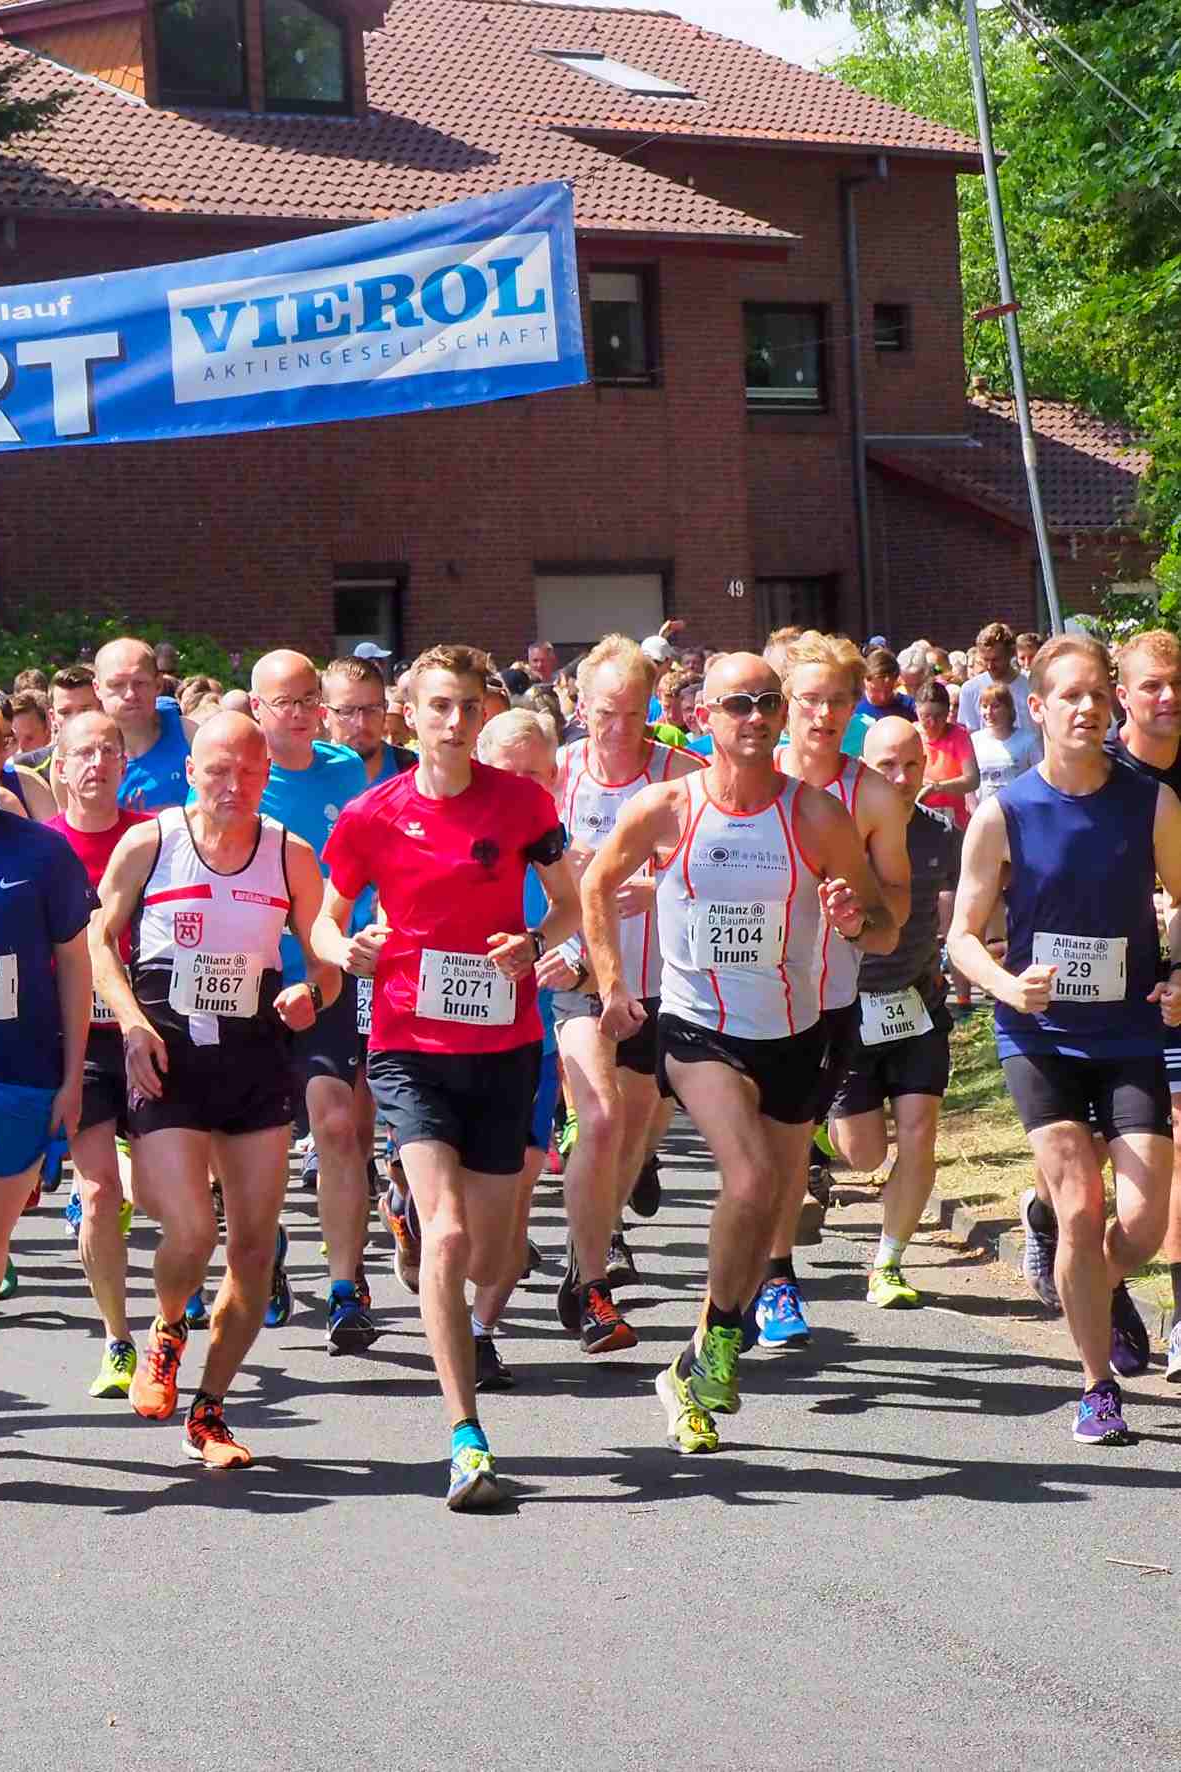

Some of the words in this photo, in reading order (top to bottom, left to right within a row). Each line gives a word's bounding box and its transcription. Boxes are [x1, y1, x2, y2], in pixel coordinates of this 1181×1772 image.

[180, 256, 547, 354] VIEROL
[203, 326, 548, 381] AKTIENGESELLSCHAFT
[727, 579, 745, 598] 49
[176, 913, 201, 922] MTV
[708, 904, 749, 916] Allianz
[720, 915, 765, 926] Baumann
[709, 927, 763, 945] 2104
[1053, 937, 1092, 950] Allianz
[195, 954, 231, 965] Allianz
[442, 955, 481, 968] Allianz
[713, 946, 759, 964] bruns
[1064, 949, 1108, 960] Baumann
[204, 965, 246, 976] Baumann
[453, 967, 497, 979] Baumann
[1067, 961, 1091, 978] 29
[195, 977, 243, 994] 1867
[441, 978, 492, 999] 2071
[1056, 978, 1099, 997] bruns
[93, 1004, 115, 1018] bru
[195, 994, 238, 1012] bruns
[443, 997, 489, 1018] bruns
[885, 1003, 905, 1019] 34
[881, 1020, 915, 1036] bruns
